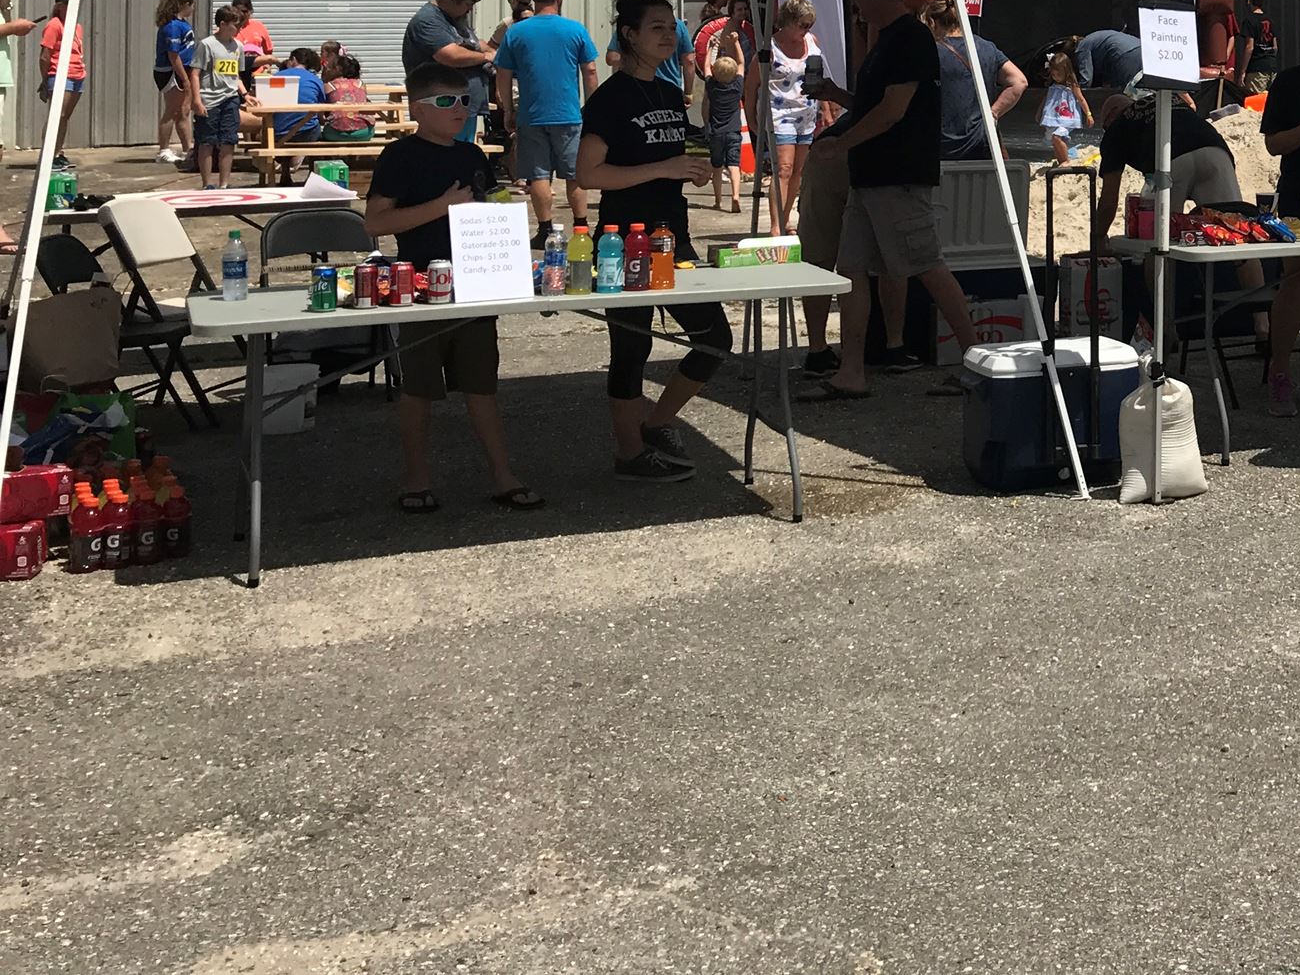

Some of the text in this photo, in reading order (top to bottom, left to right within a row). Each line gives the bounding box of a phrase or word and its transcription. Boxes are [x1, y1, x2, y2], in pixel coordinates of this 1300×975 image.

[1158, 15, 1178, 26] Face
[1151, 31, 1188, 46] Painting
[1158, 50, 1184, 61] $2.00
[218, 60, 237, 73] 276
[486, 215, 508, 224] $2.00
[489, 227, 511, 236] $2.00
[487, 251, 510, 261] $1.00
[491, 264, 513, 273] $2.00
[629, 259, 641, 273] G
[141, 531, 154, 545] G
[166, 528, 179, 541] G
[106, 534, 120, 548] G
